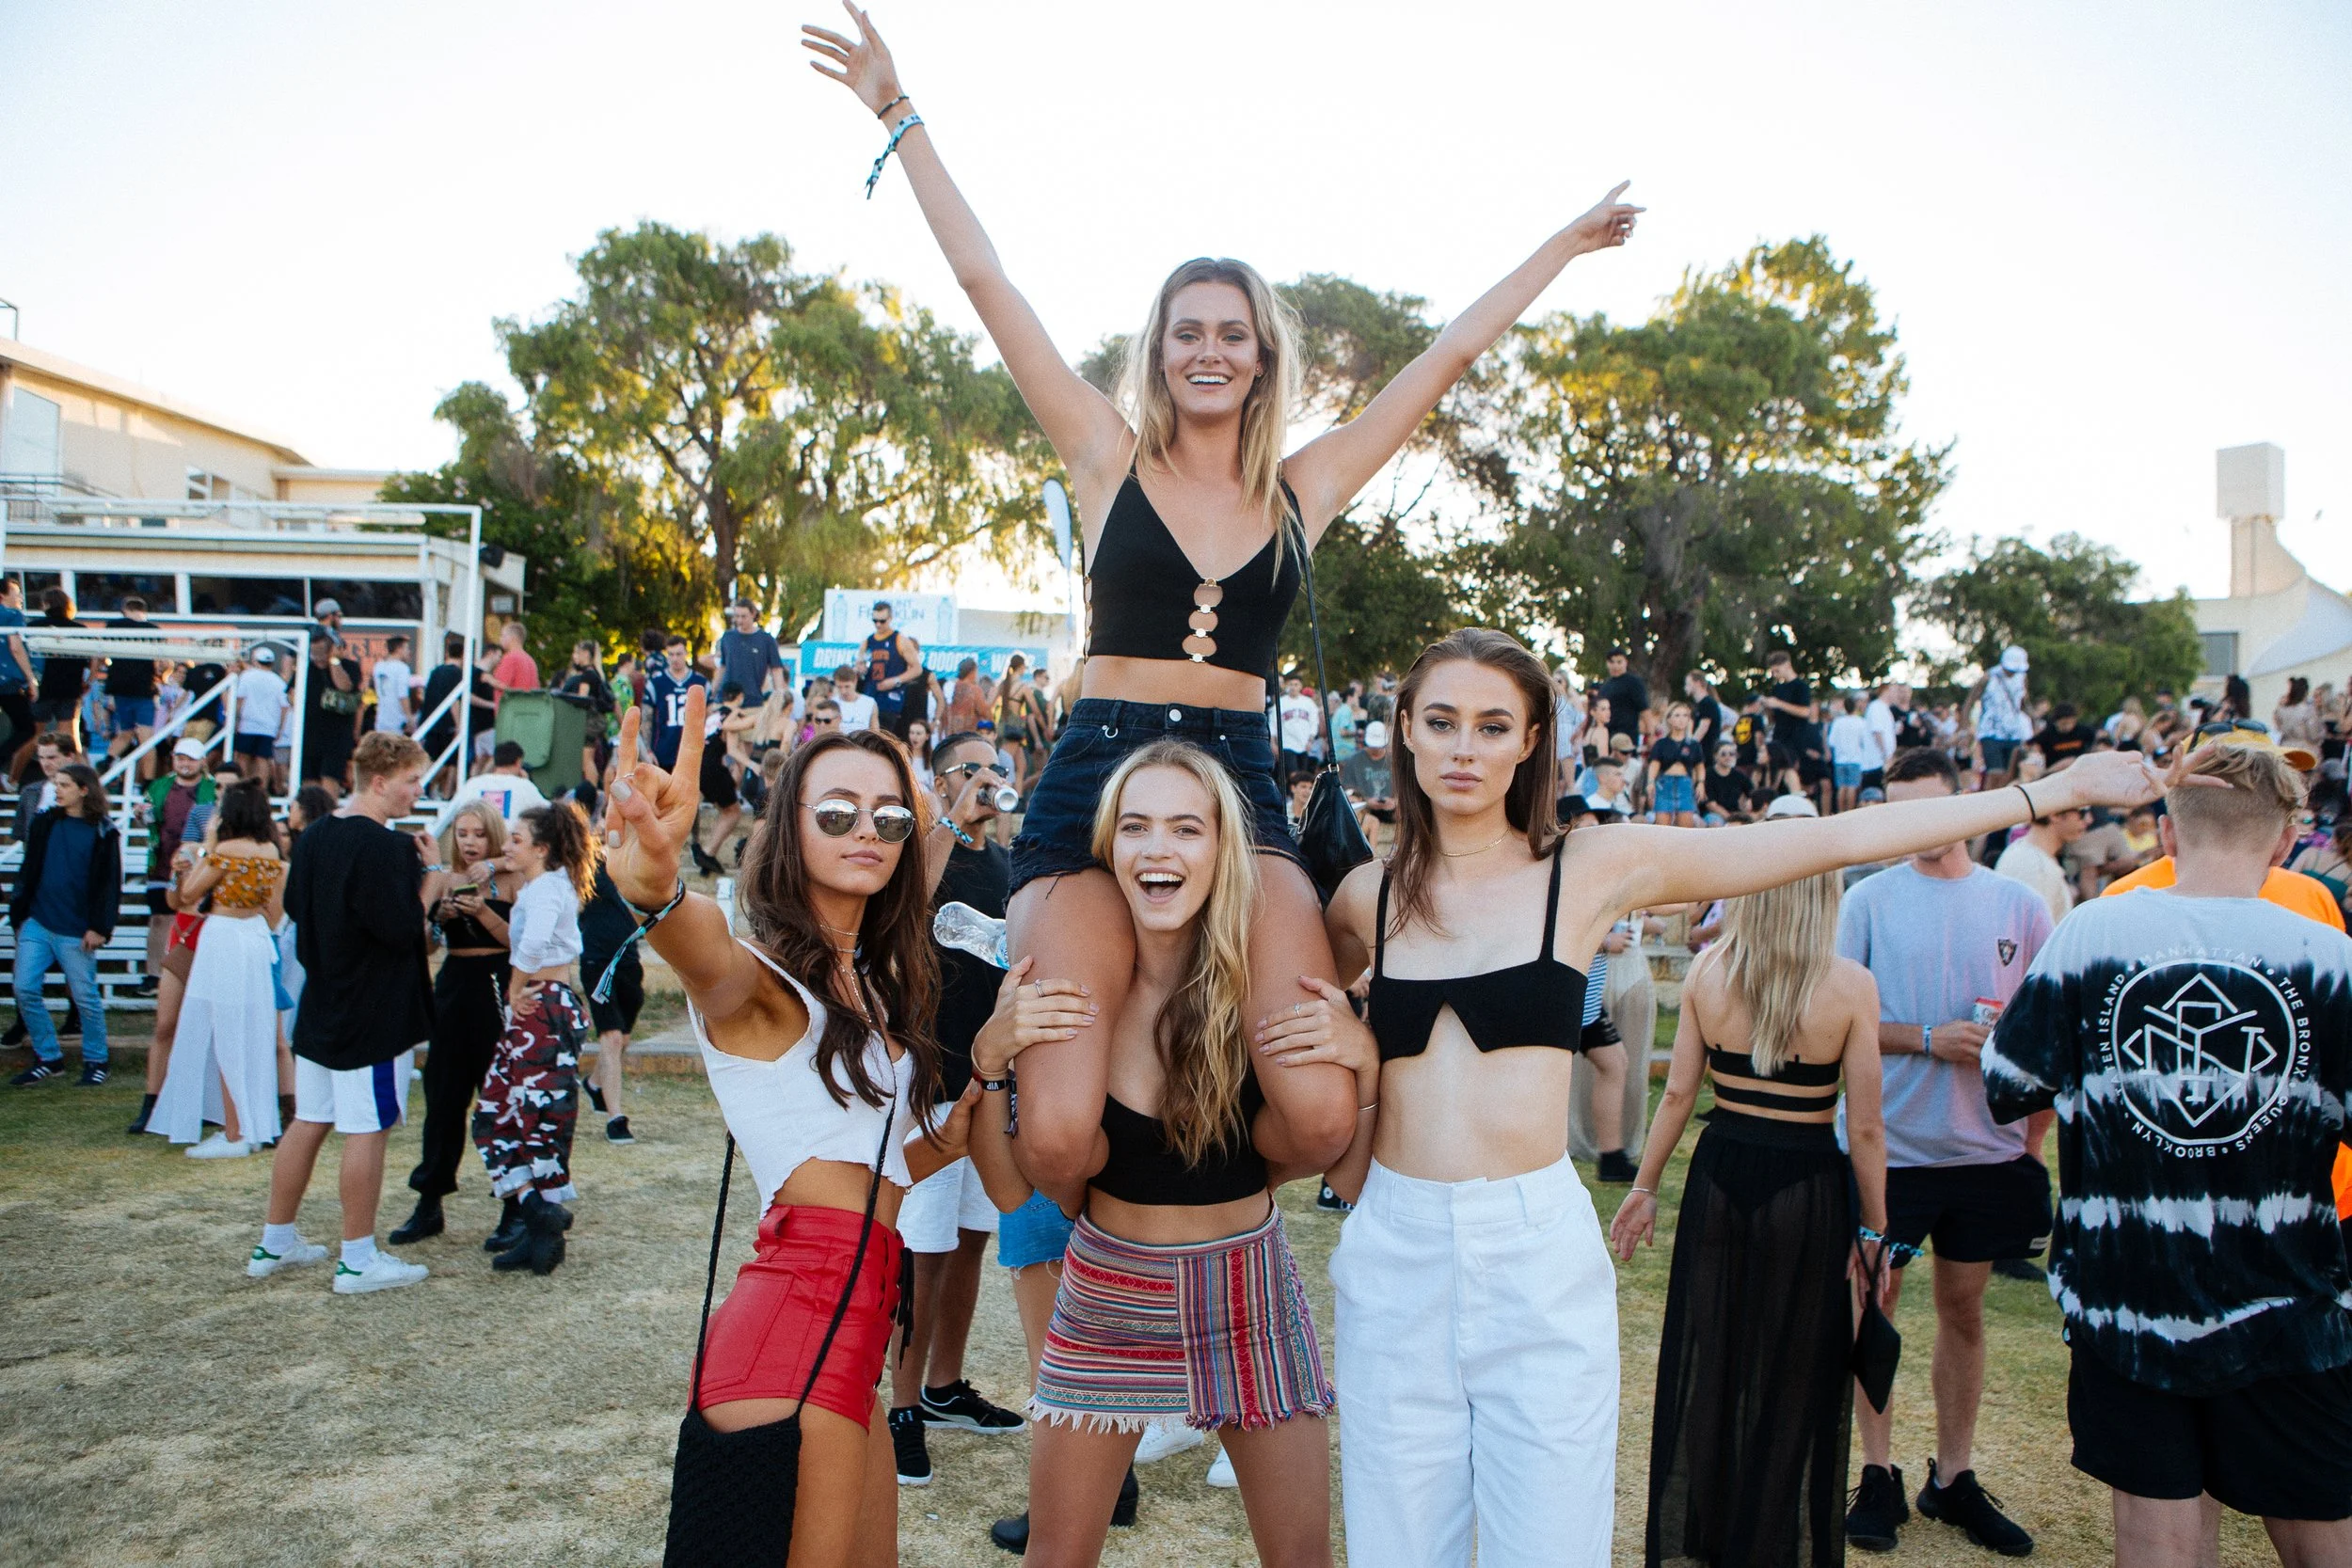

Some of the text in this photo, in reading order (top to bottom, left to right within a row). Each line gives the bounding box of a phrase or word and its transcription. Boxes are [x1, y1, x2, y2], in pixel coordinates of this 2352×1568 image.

[2138, 946, 2263, 969] MANHATTAN
[2098, 974, 2125, 1033] ISLAND
[2279, 977, 2311, 1078] THE BRONX
[986, 1082, 999, 1090] VIP
[2132, 1121, 2217, 1159] BROOKLYN
[2234, 1095, 2289, 1151] QUEENS
